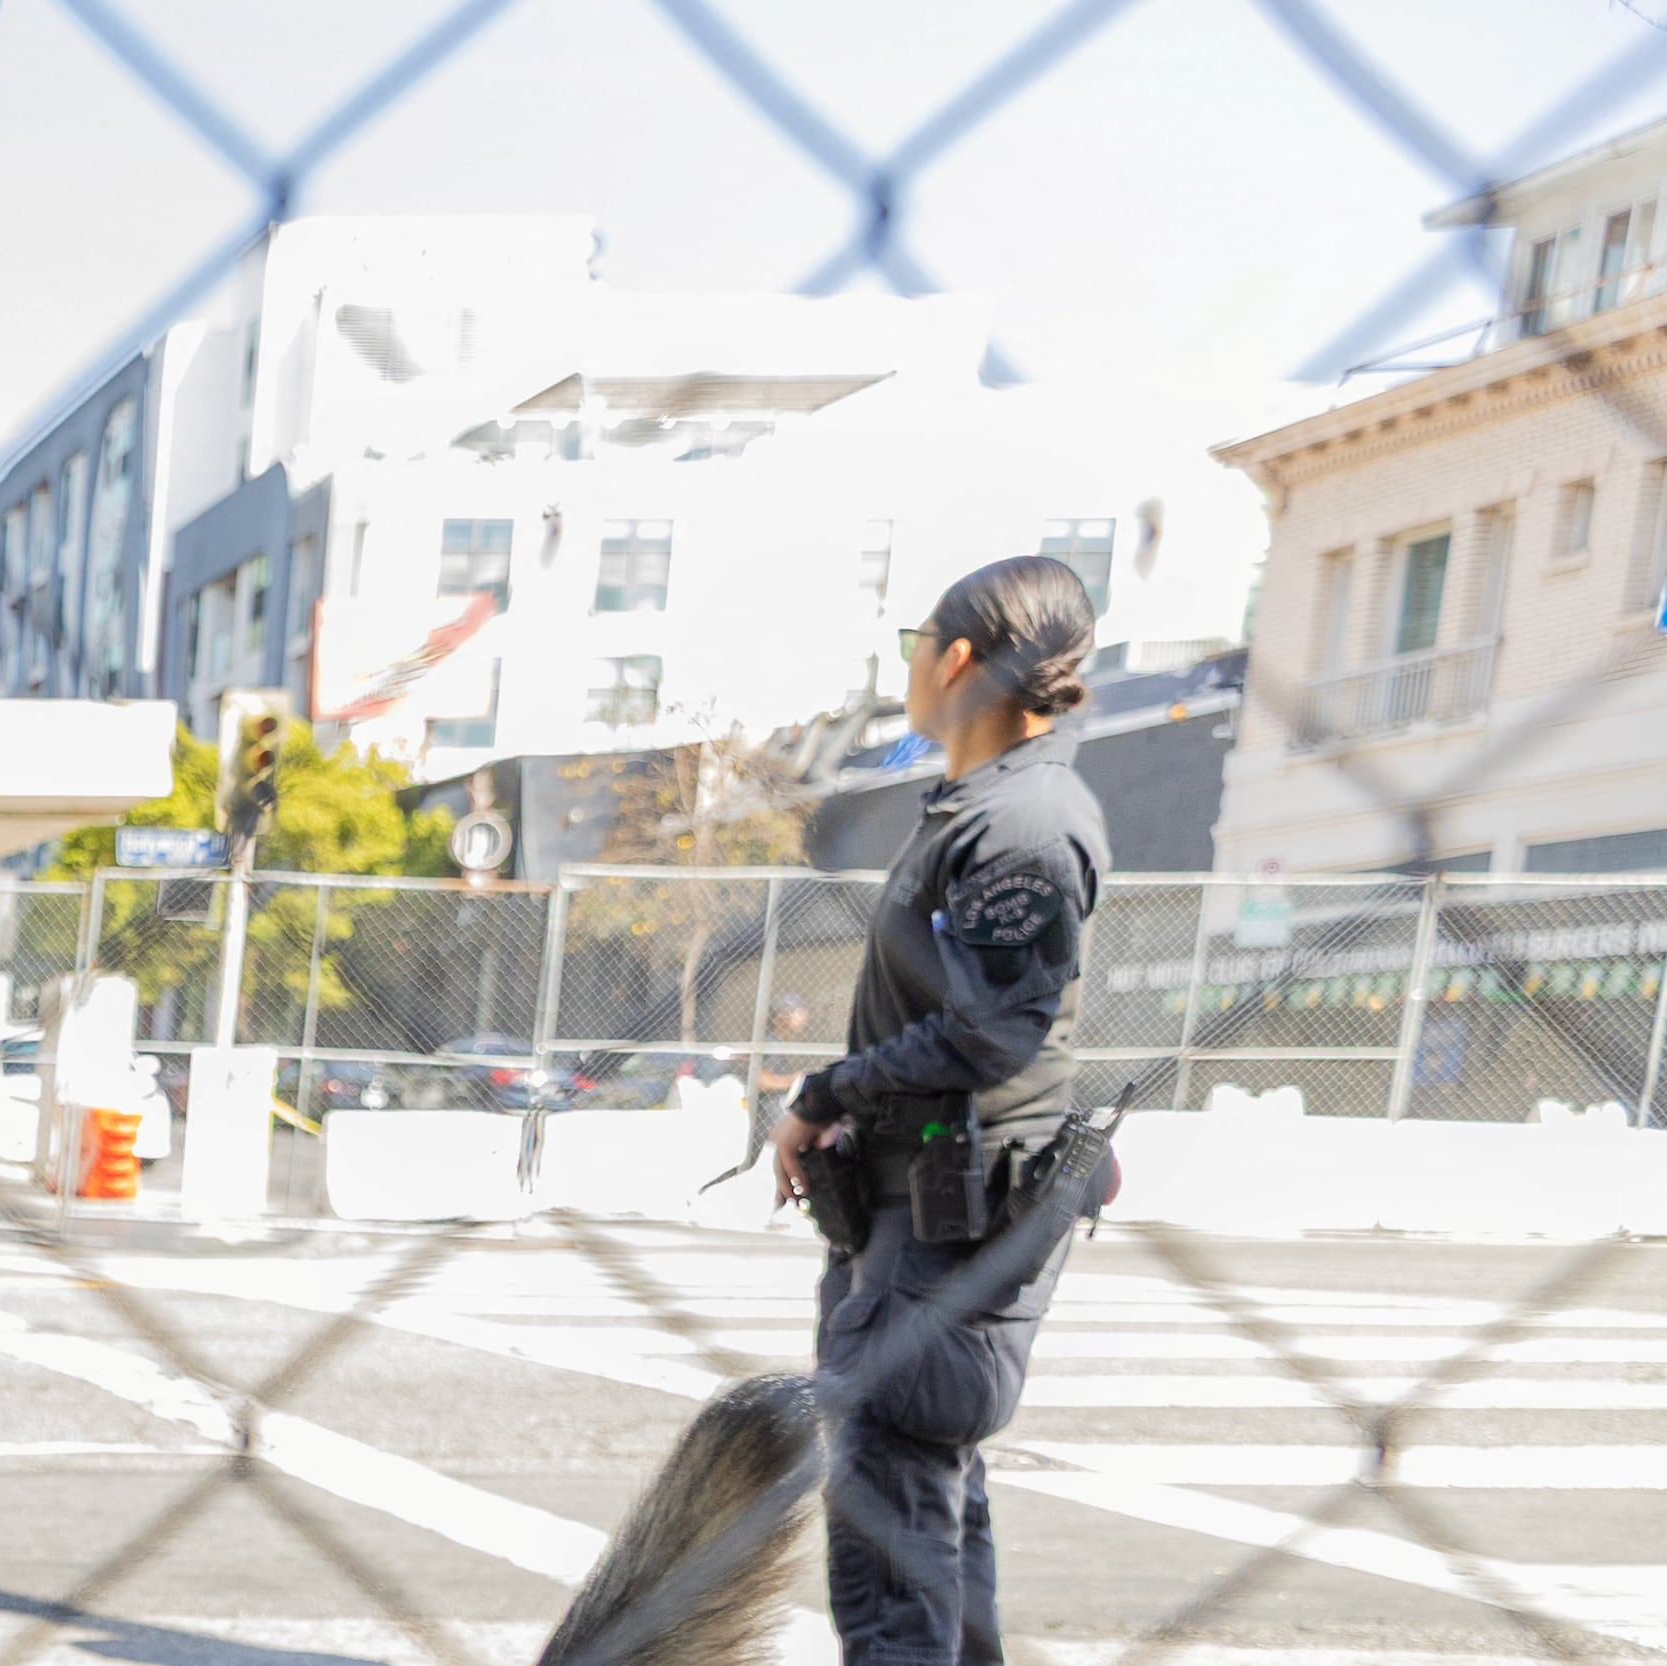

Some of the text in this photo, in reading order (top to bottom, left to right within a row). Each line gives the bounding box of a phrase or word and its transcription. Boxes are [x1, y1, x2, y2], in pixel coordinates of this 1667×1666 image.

[963, 877, 1053, 929] LOS ANGELES
[994, 913, 1042, 941] POLICE
